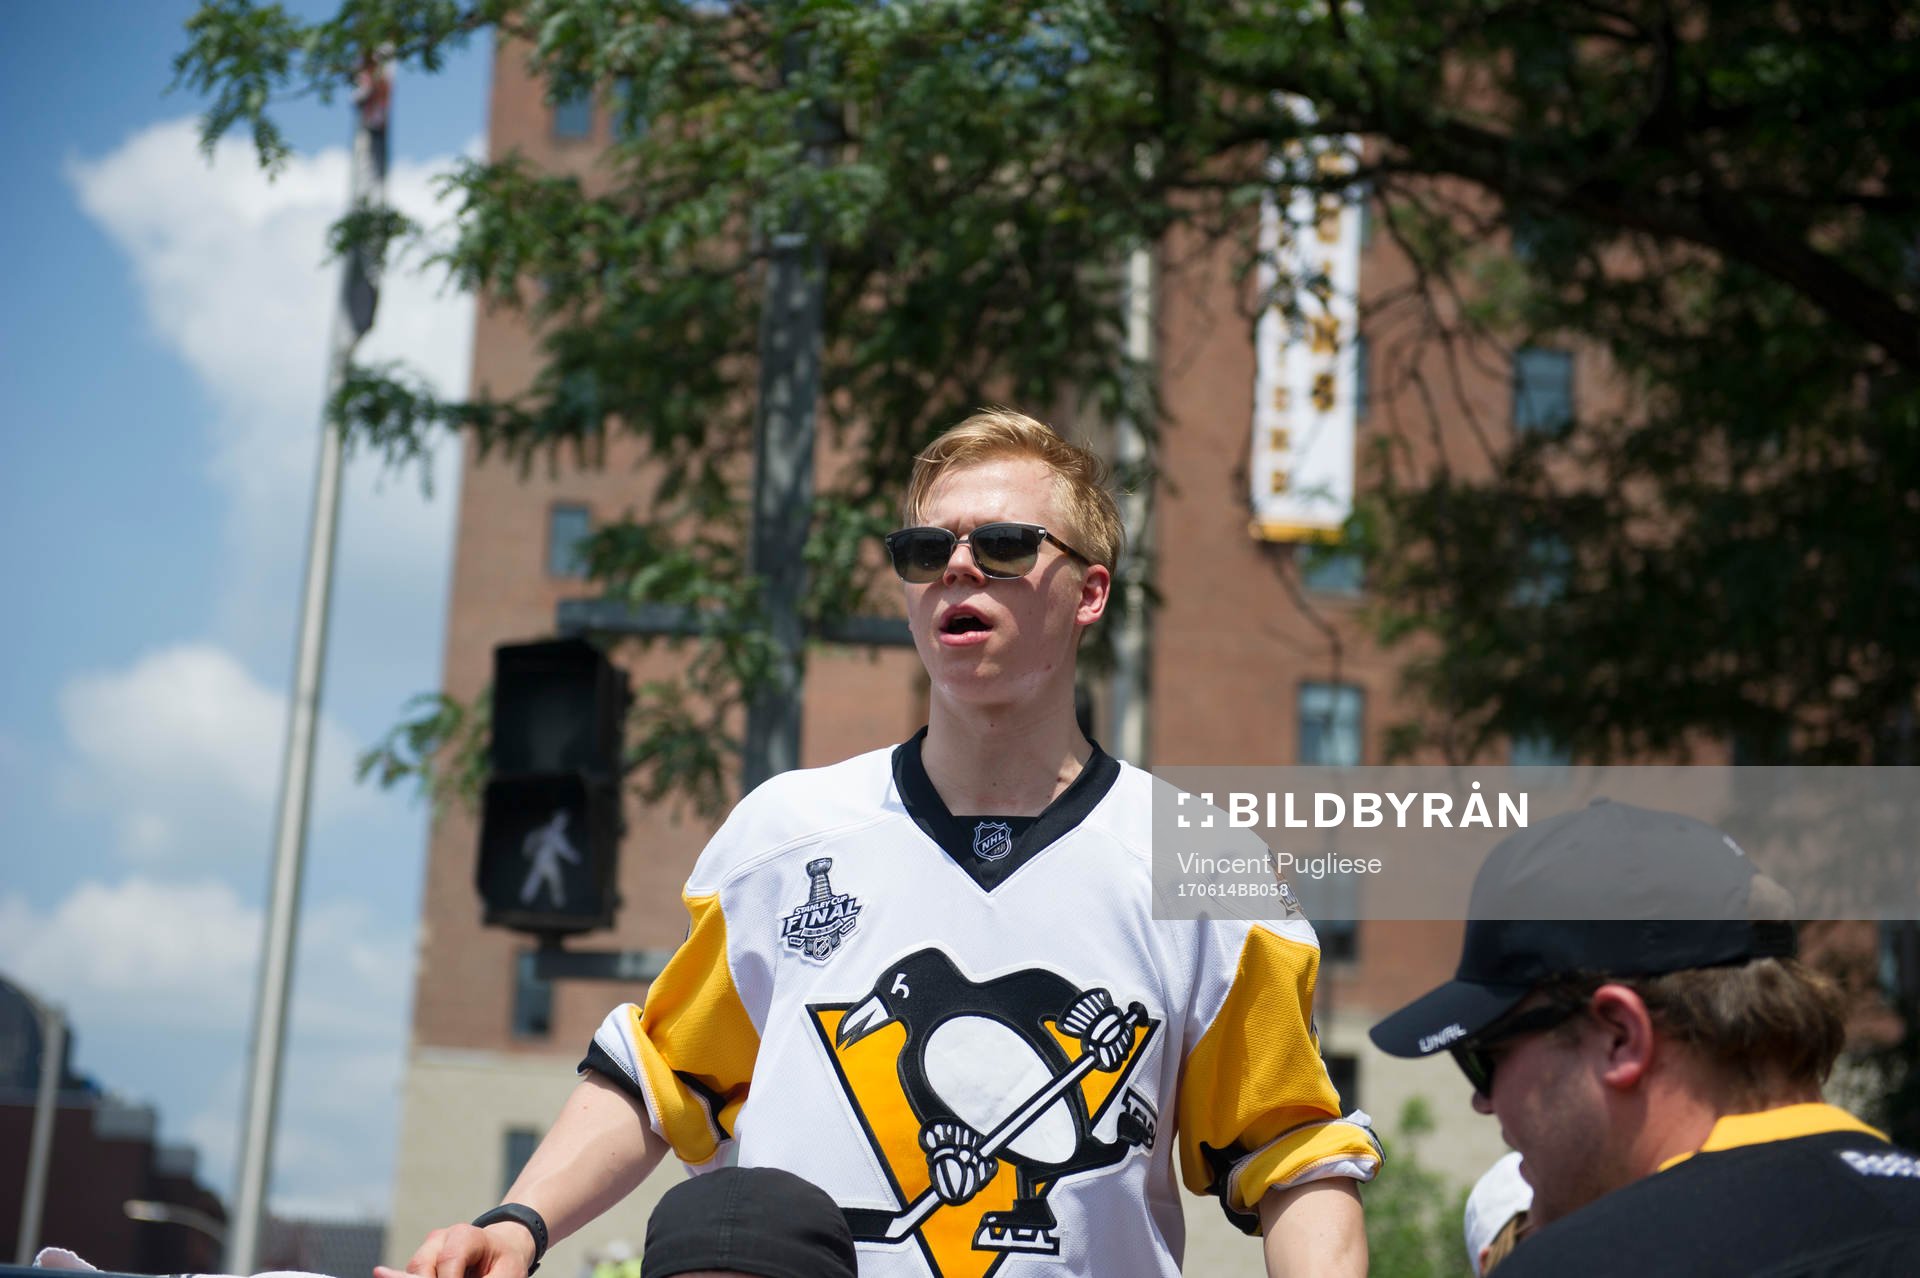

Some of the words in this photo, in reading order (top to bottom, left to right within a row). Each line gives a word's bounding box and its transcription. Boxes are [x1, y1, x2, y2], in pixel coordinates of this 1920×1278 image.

[981, 832, 1005, 852] NHL
[784, 899, 860, 934] FINAL
[794, 901, 831, 915] STANLEY
